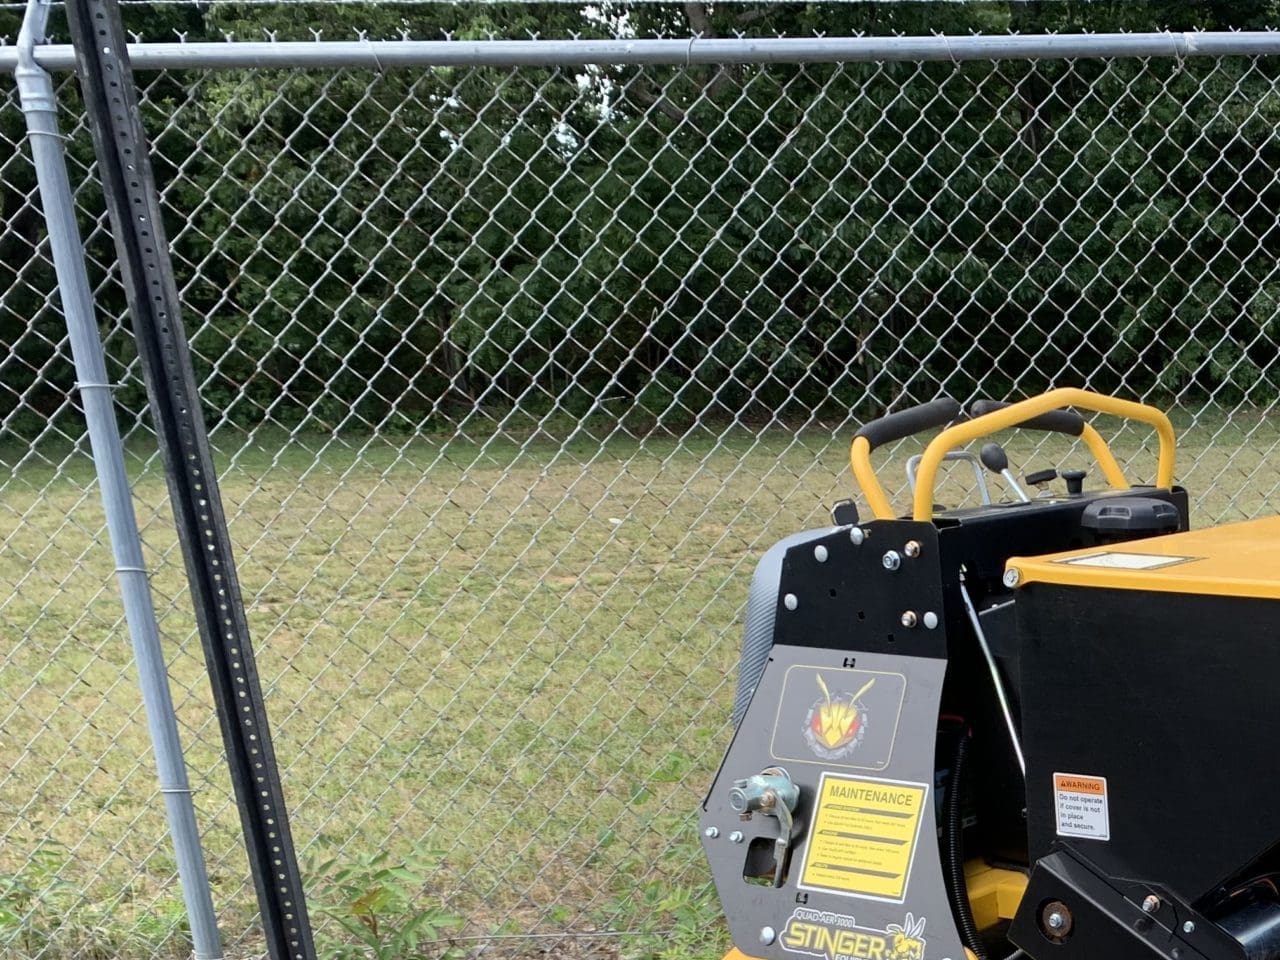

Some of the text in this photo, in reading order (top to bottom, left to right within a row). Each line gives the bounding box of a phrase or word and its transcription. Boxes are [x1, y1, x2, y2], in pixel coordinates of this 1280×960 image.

[1066, 781, 1100, 791] WARNING
[829, 785, 913, 806] MAINTENANCE
[1059, 793, 1068, 801] Do
[1067, 812, 1083, 820] place
[784, 922, 886, 960] STINGER
